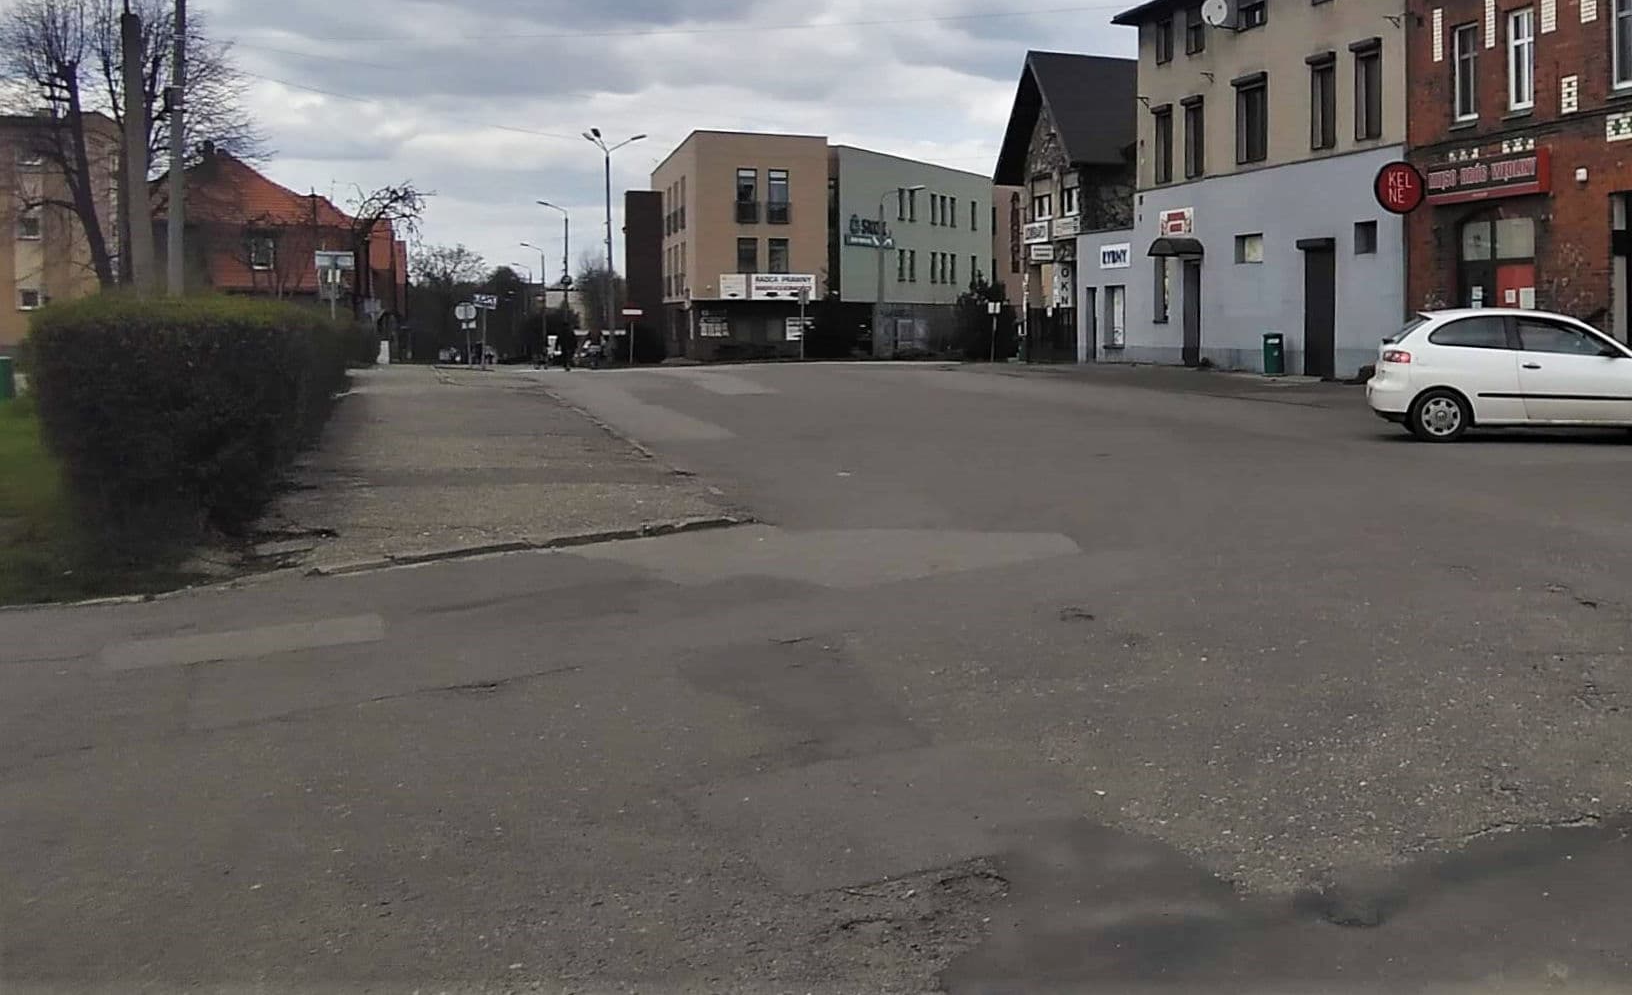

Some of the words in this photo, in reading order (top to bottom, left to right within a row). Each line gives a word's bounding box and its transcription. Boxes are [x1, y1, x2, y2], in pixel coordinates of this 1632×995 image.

[1388, 172, 1413, 189] KEL
[1388, 188, 1405, 204] NE
[1060, 268, 1070, 306] OKN
